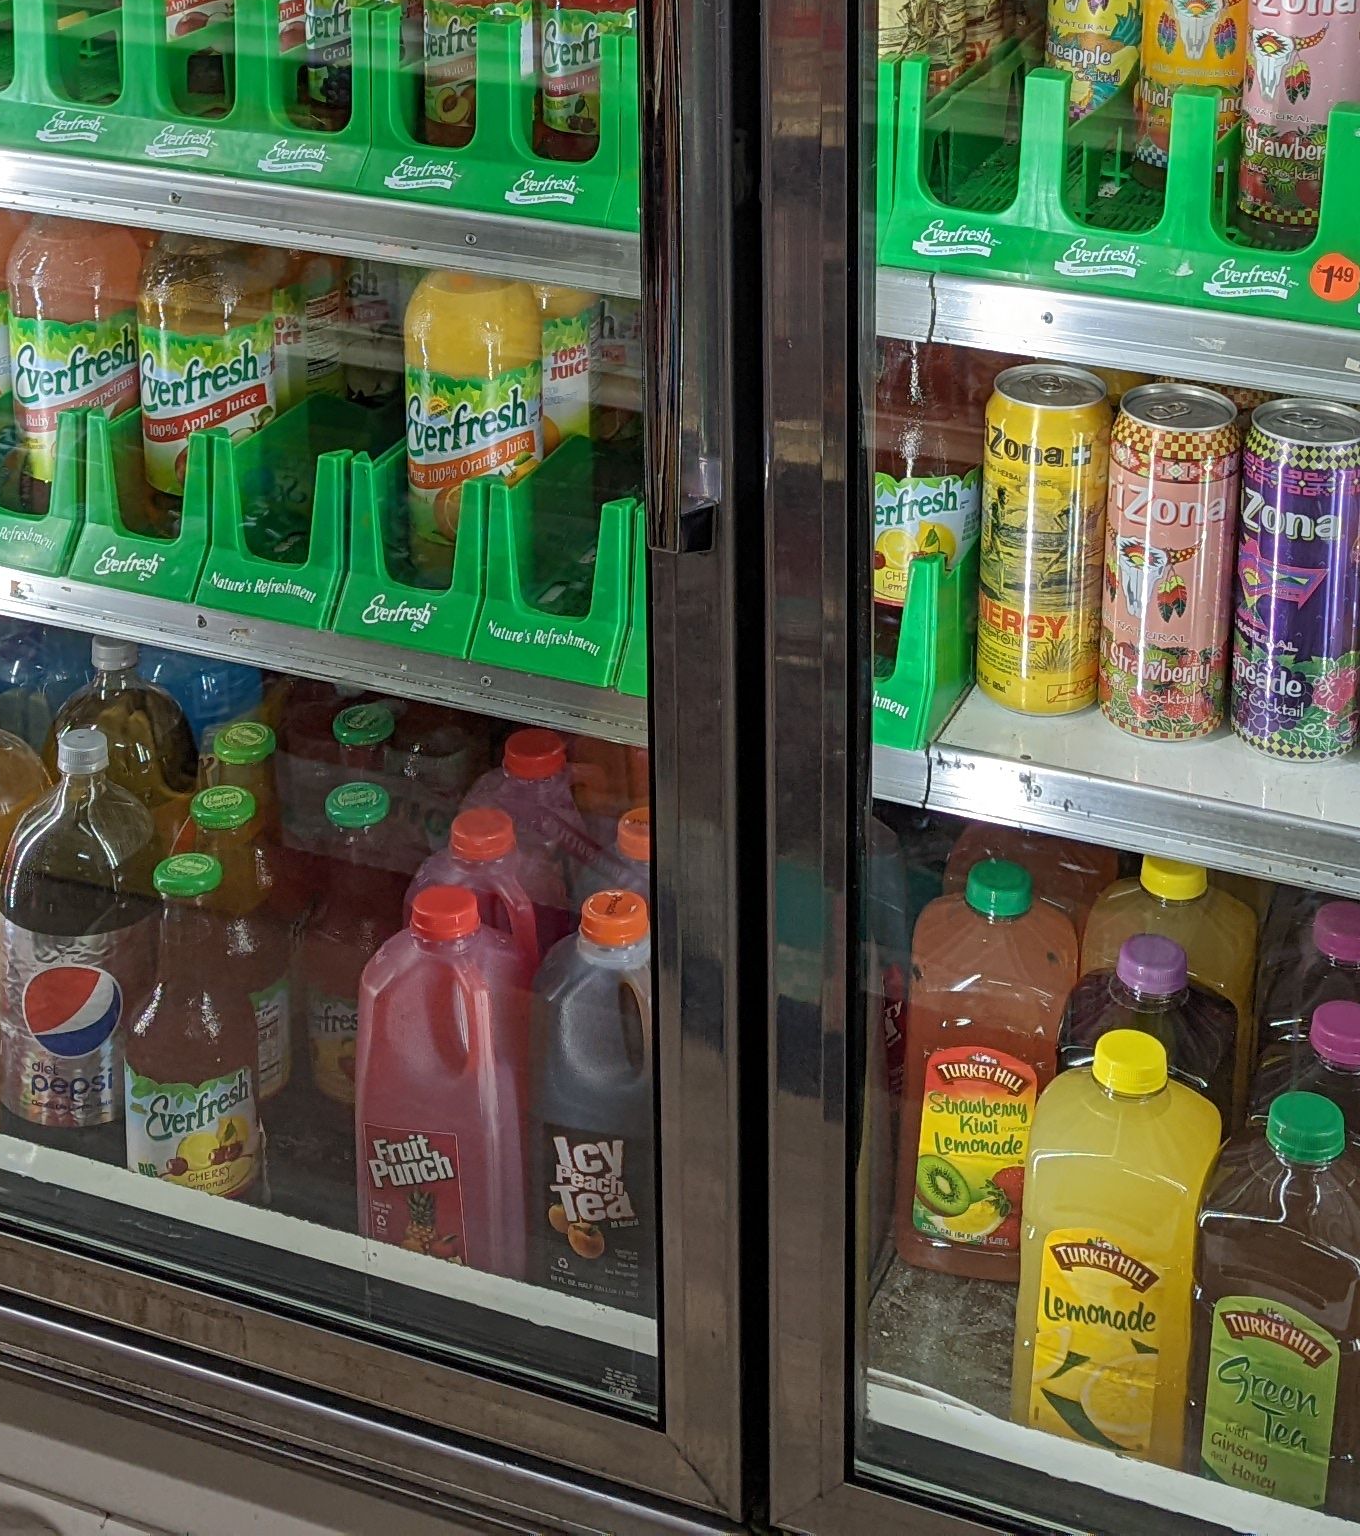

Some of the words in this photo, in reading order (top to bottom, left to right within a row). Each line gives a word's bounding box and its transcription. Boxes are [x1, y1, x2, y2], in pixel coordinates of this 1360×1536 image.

[920, 220, 992, 247] Everfresh
[1063, 237, 1136, 266] Everfresh
[1211, 258, 1287, 287] Everfresh
[15, 322, 137, 403] Everfresh
[139, 339, 259, 412] Everfresh
[549, 359, 589, 382] JUICE
[180, 407, 222, 435] Apple
[223, 391, 258, 416] Juice
[406, 388, 529, 457] Everfresh
[459, 443, 504, 474] Orange
[505, 435, 531, 455] Juice
[94, 548, 159, 576] Everfresh
[209, 572, 253, 599] Nature's
[254, 576, 317, 604] Refreshment
[362, 593, 433, 625] Everfresh
[487, 620, 531, 646] Nature's
[535, 628, 601, 656] Refreshment
[1109, 652, 1211, 685] Strawberry
[31, 1065, 113, 1100] pepsi
[146, 1070, 251, 1142] Everfresh
[929, 1093, 1029, 1122] Strawberry
[958, 1115, 1000, 1136] Kiwi
[373, 1133, 433, 1162] Fruit
[553, 1135, 624, 1177] Icy
[933, 1132, 1024, 1157] Lemonade
[188, 1166, 230, 1183] CHERRY
[369, 1153, 455, 1189] Punch
[555, 1164, 625, 1196] Peach
[549, 1185, 635, 1224] Tea
[1044, 1286, 1158, 1334] Lemonade
[1217, 1357, 1321, 1419] Green
[1253, 1402, 1310, 1454] Tea
[1210, 1431, 1269, 1470] Ginseng
[1229, 1462, 1276, 1495] Honey
